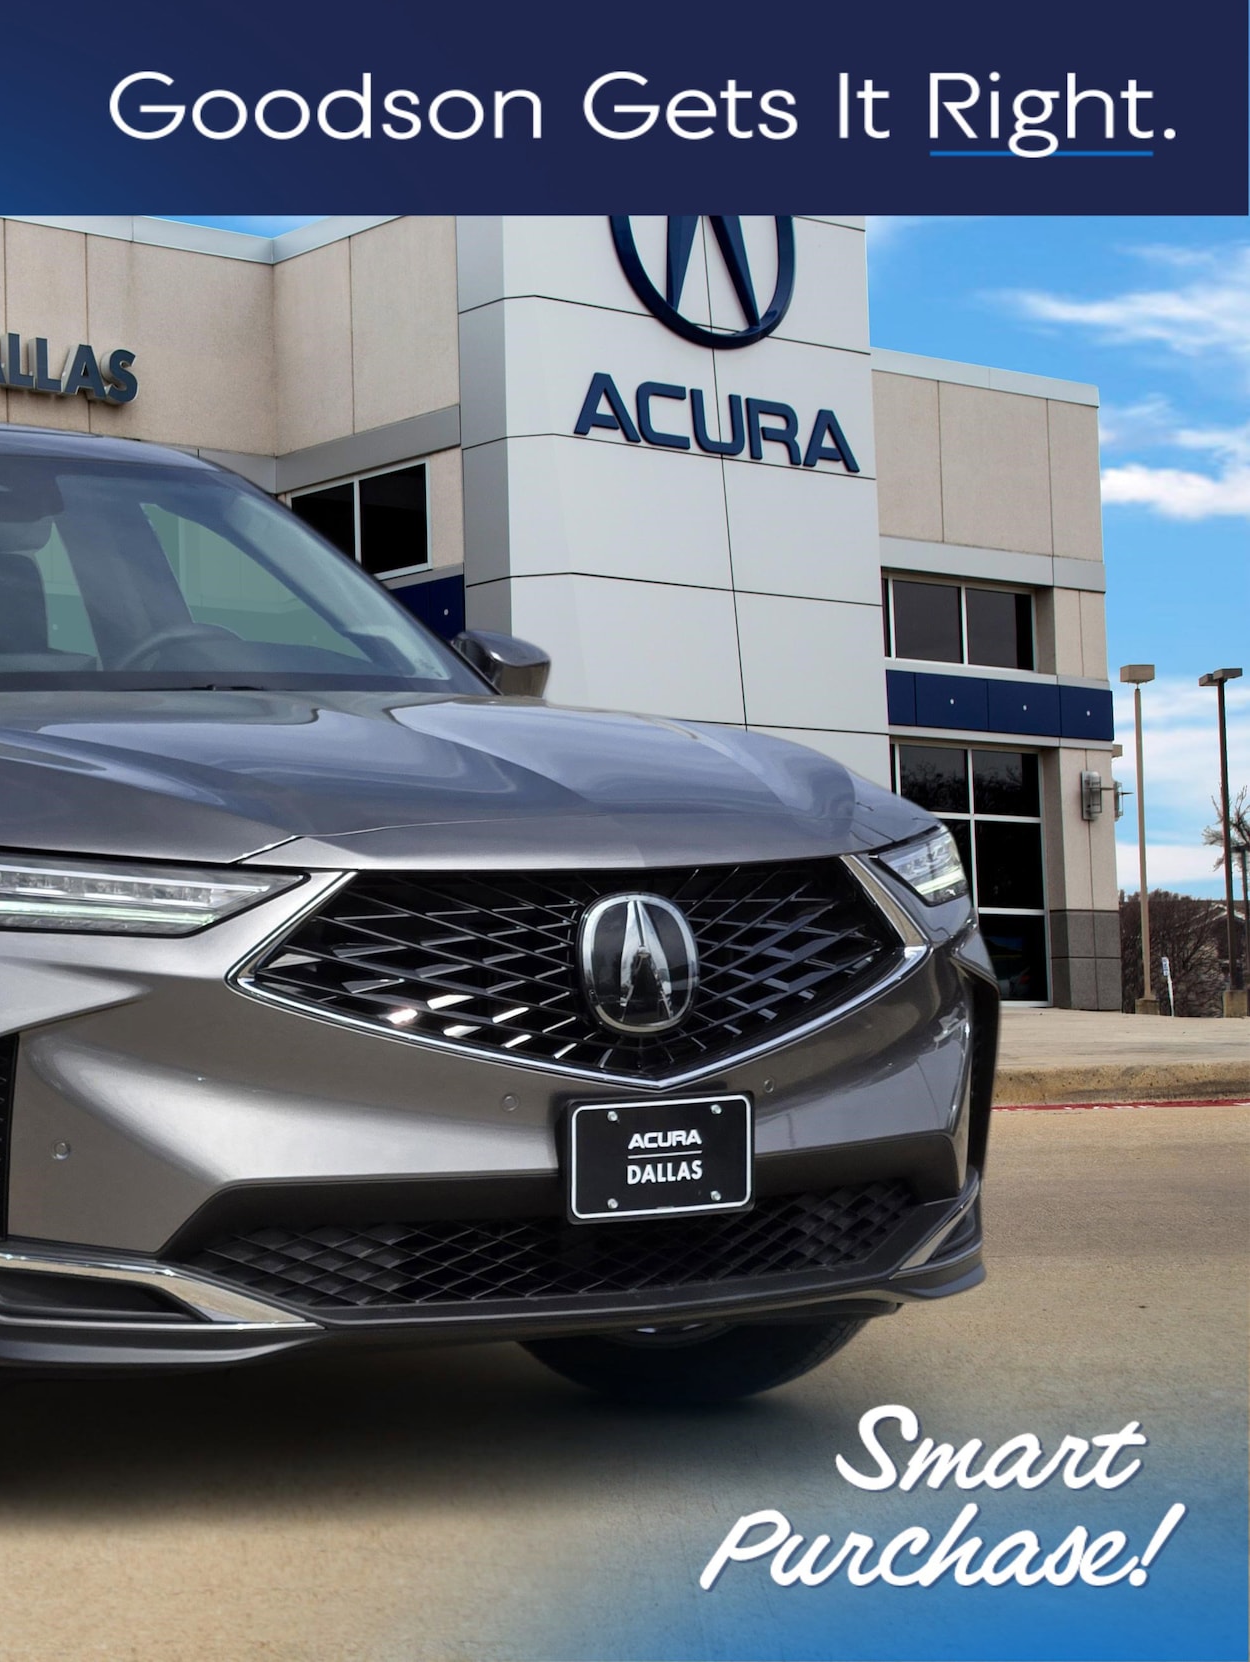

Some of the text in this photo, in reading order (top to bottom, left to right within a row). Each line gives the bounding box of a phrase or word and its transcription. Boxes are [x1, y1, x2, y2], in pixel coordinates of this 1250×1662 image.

[573, 372, 861, 473] ACURA
[627, 1129, 703, 1150] ACURA
[626, 1159, 703, 1185] DALLAS
